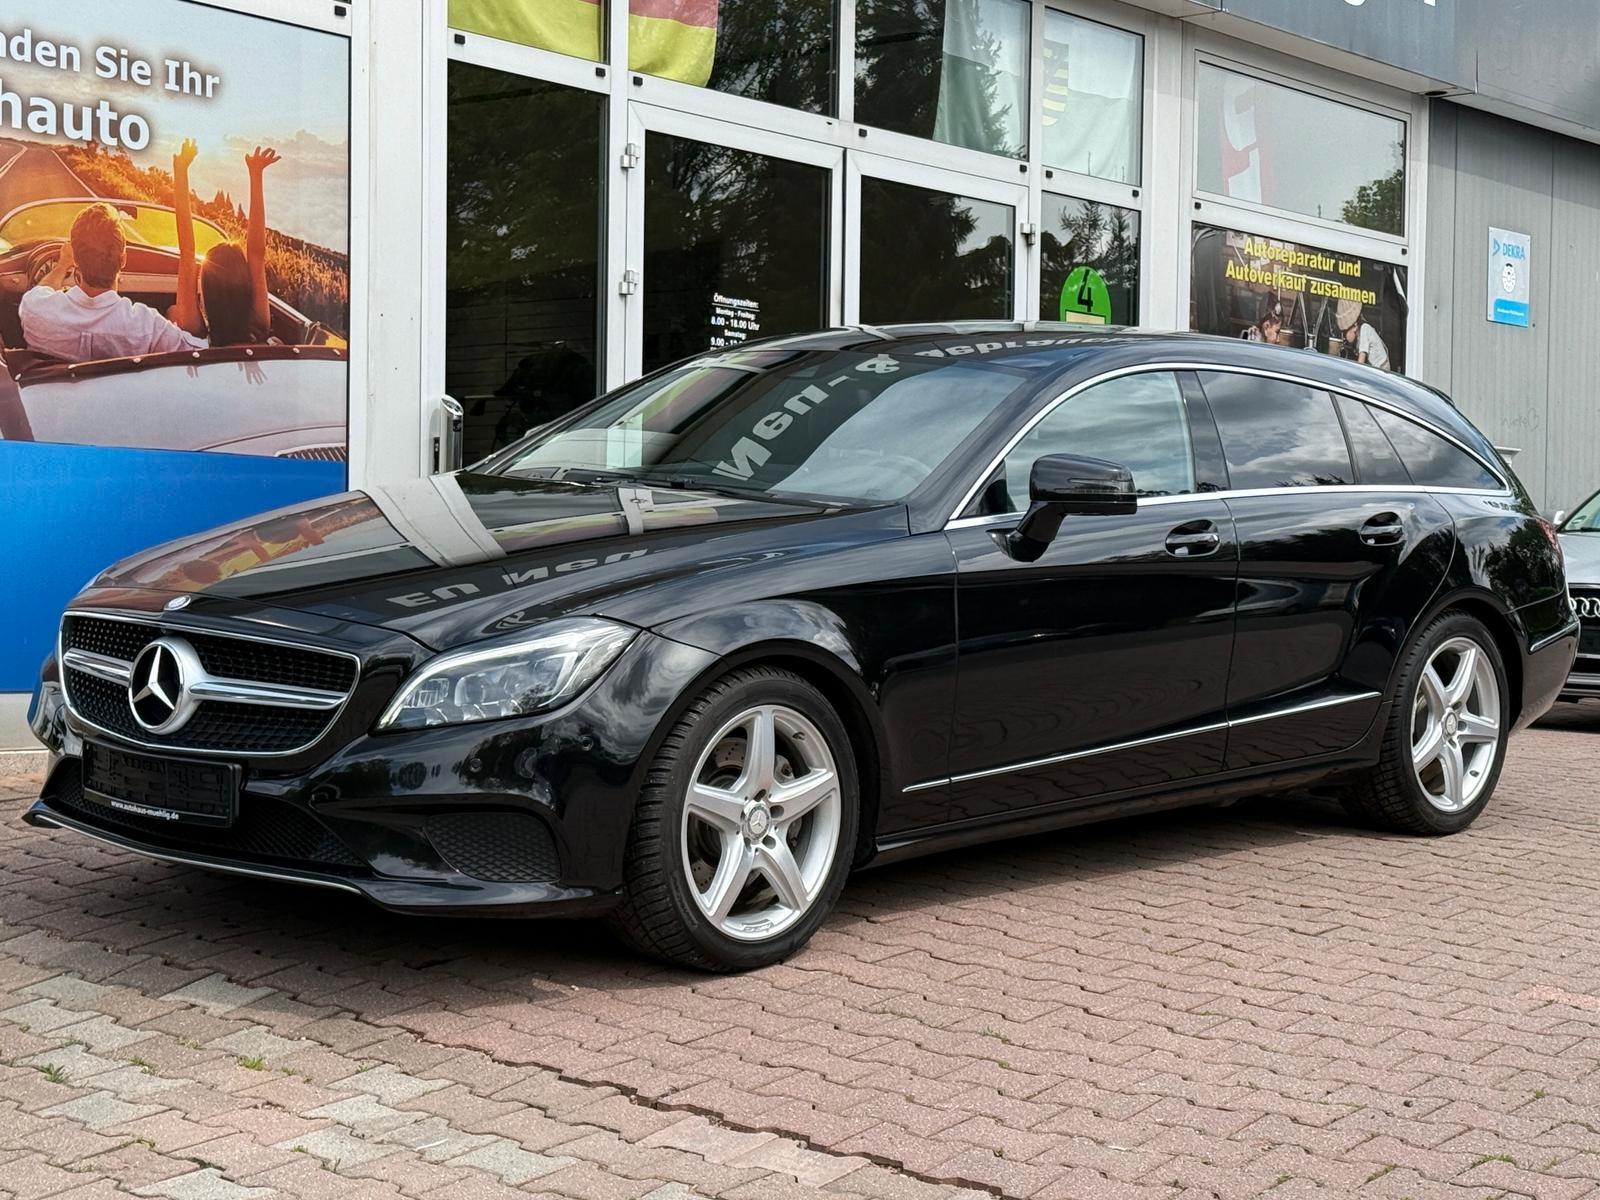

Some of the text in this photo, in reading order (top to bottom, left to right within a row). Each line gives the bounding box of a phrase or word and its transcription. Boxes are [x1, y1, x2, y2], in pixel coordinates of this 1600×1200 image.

[95, 46, 151, 86] Sie
[164, 59, 220, 98] Ihr
[1243, 238, 1361, 277] Autoreparatur und
[1503, 242, 1525, 260] DEKRA
[1077, 268, 1094, 312] 4
[1225, 259, 1377, 305] Autoverkauf zusammen
[711, 316, 725, 326] 8.00
[730, 319, 747, 329] 18.00
[748, 321, 760, 330] Uhr
[711, 336, 724, 346] 9.00
